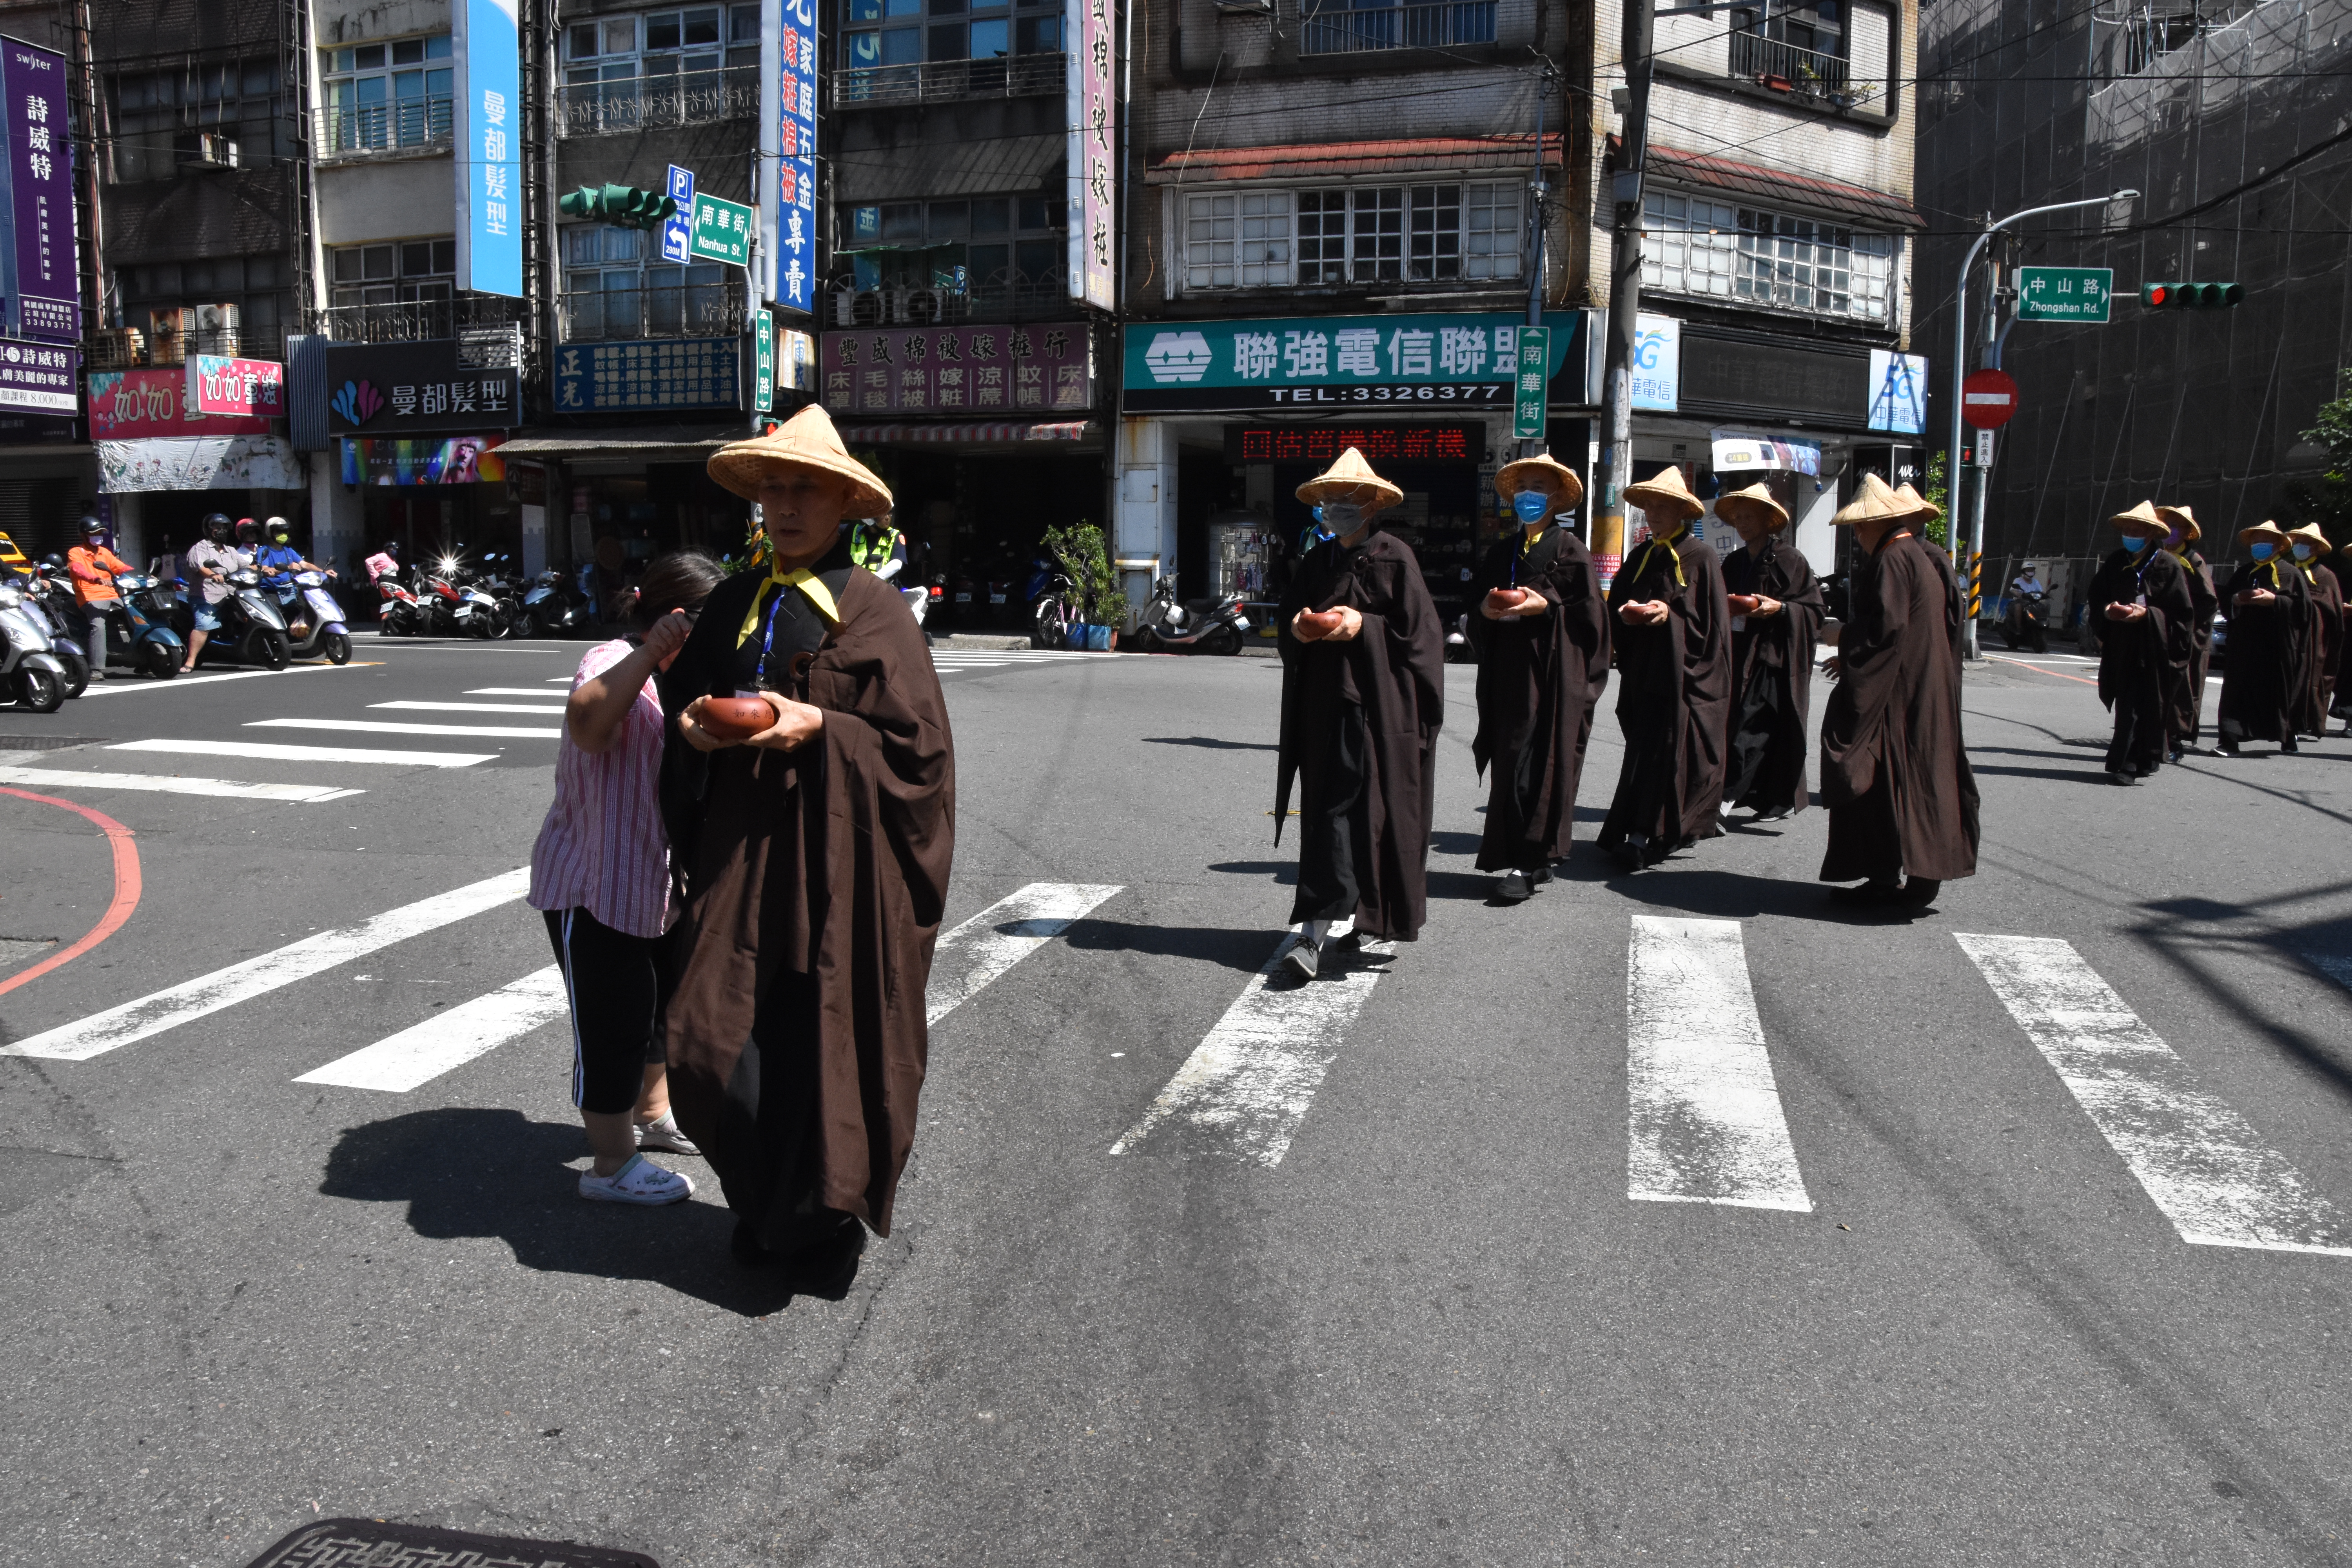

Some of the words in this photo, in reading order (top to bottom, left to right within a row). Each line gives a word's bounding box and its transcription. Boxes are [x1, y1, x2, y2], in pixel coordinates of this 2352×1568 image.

[27, 95, 52, 181] 詩威特
[798, 36, 813, 212] 家庭五金
[484, 90, 507, 235] 曼都髮型
[675, 173, 685, 194] P
[702, 205, 745, 234] 南華街
[40, 196, 51, 280] 肌膚美麗的專家
[666, 245, 680, 256] 290M
[699, 235, 728, 254] Nanhua
[731, 243, 742, 257] St.
[785, 209, 806, 304] 專賣
[2031, 277, 2100, 294] 中山路
[24, 300, 71, 314] 桃園南華加盟店
[26, 318, 71, 330] 3389373
[2030, 301, 2080, 314] Zhongshan
[2083, 303, 2099, 314] Rd.
[22, 348, 67, 368] 詩威特
[759, 326, 770, 394] 中山路
[0, 368, 68, 386] 膚美麗的專家
[206, 370, 277, 405] 如如童裝
[560, 349, 583, 407] 正光
[828, 372, 851, 409] 床罩
[864, 370, 887, 408] 毛毯
[902, 369, 925, 408] 絲被
[940, 367, 963, 407] 嫁粧
[1017, 365, 1042, 405] 蚊帳
[1269, 385, 1500, 402] TEL:3326377
[1520, 345, 1543, 420] 南華街
[1882, 365, 1914, 399] 5G
[392, 379, 508, 416] 曼都髮型
[1875, 405, 1921, 426] 中華電信
[1980, 434, 1989, 463] 禁止進入
[369, 475, 439, 485] FNTASY
